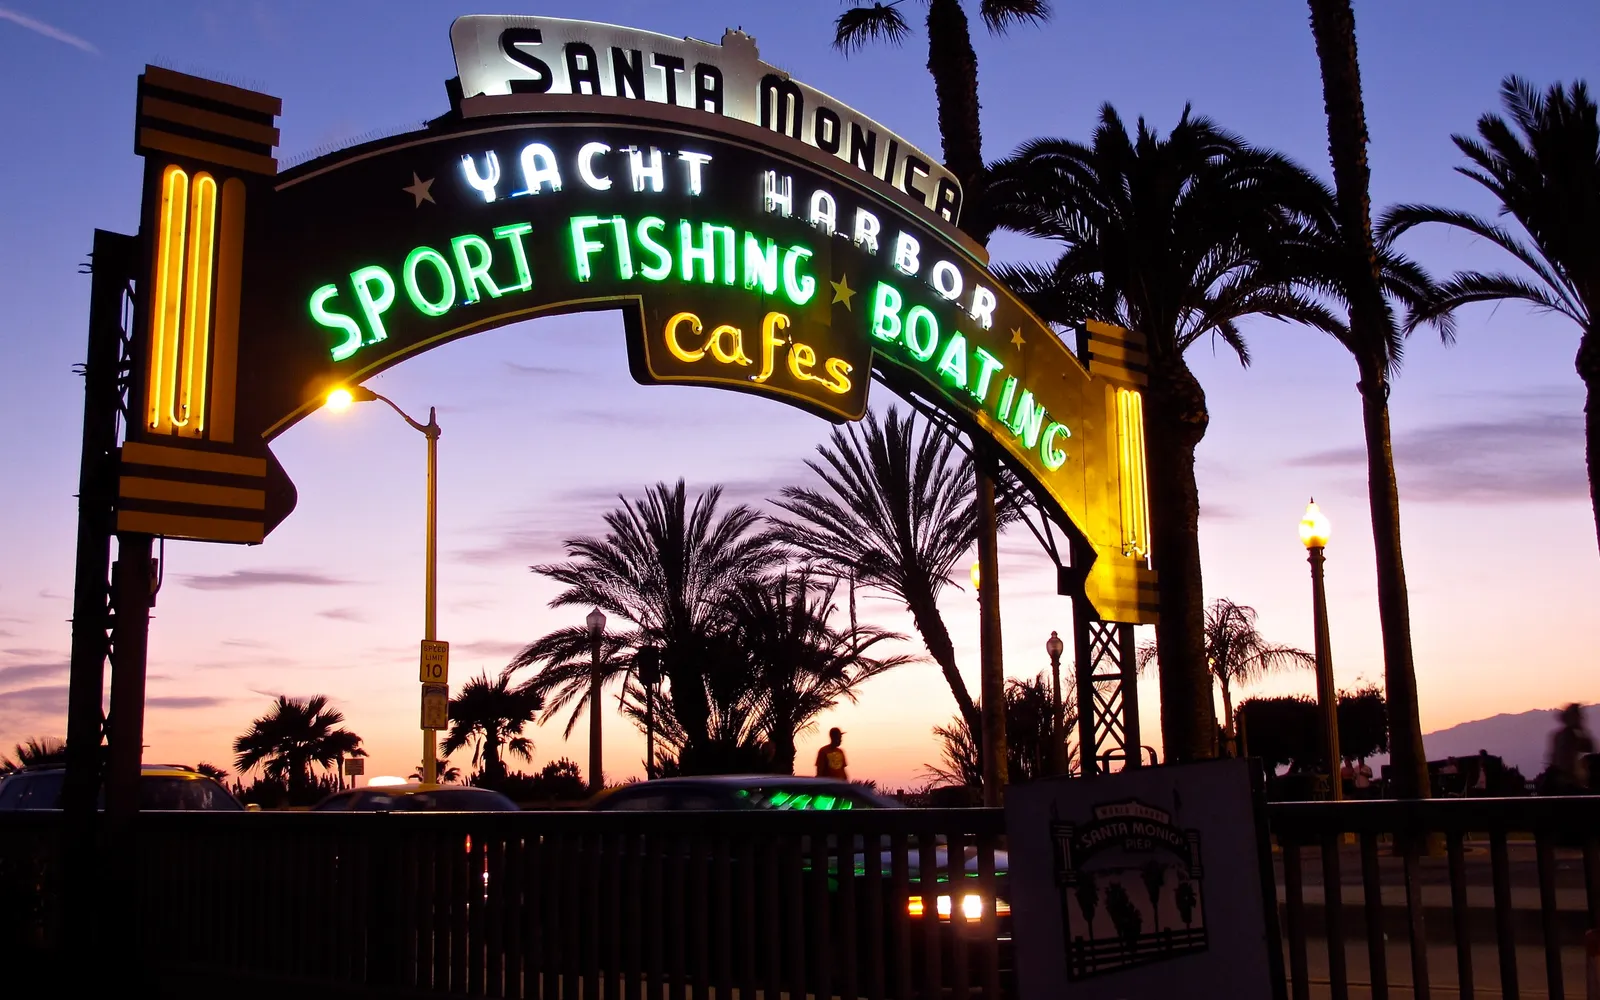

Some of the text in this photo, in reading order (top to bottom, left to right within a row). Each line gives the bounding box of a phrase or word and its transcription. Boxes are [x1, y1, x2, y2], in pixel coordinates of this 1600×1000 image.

[501, 27, 961, 228] SANTA MONICA
[461, 141, 997, 331] YACHT HARBOR
[308, 213, 1071, 472] SPORT FISHING BOATING
[664, 310, 854, 395] Cafes
[424, 645, 446, 653] SPEED
[425, 663, 443, 678] 10
[1080, 821, 1184, 849] SANTA MONICA
[1124, 838, 1153, 850] PIER
